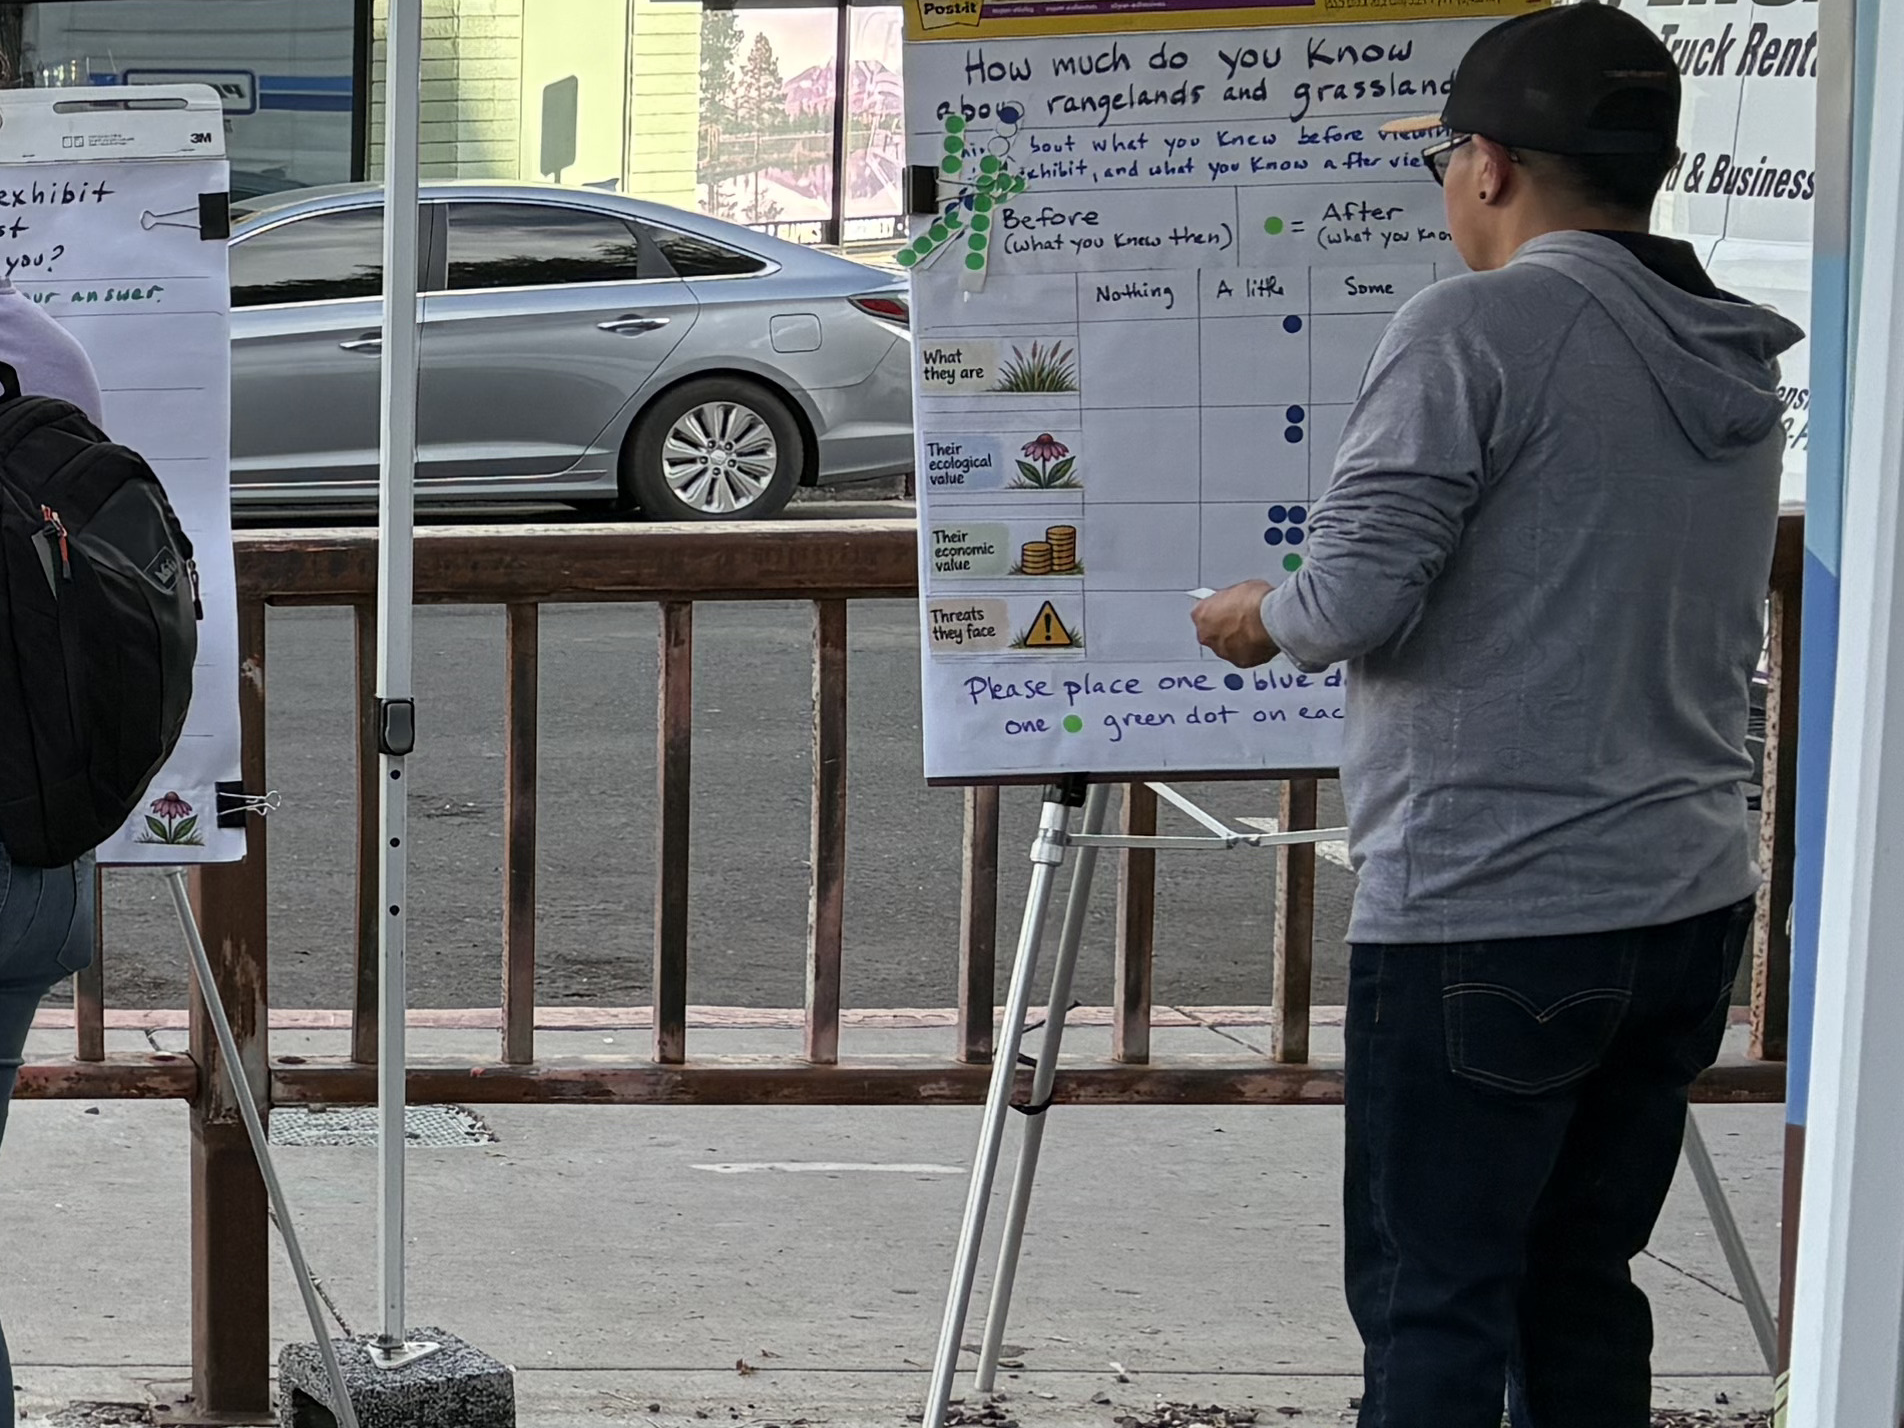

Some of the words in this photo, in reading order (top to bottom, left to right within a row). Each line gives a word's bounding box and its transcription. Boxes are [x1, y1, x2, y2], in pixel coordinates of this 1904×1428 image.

[923, 2, 977, 16] Post-it
[1661, 22, 1737, 77] Truck
[965, 48, 1032, 85] How
[1052, 42, 1131, 78] much
[1148, 41, 1189, 70] do
[1218, 47, 1282, 80] you
[936, 94, 1007, 122] abou
[1047, 80, 1205, 128] rangelands
[1223, 77, 1268, 102] and
[1290, 69, 1457, 123] grassland
[190, 132, 212, 144] 3M
[1030, 134, 1076, 154] bout
[1092, 132, 1148, 152] what
[1164, 136, 1200, 159] you
[1298, 125, 1364, 146] before
[1104, 159, 1139, 177] and
[1149, 159, 1195, 176] what
[1209, 161, 1240, 182] you
[1389, 152, 1425, 167] vie
[1683, 152, 1707, 194] &
[1705, 153, 1816, 201] Business
[1003, 207, 1099, 231] Before
[1322, 200, 1404, 222] After
[1004, 232, 1065, 255] (what
[1068, 234, 1104, 255] you
[1169, 223, 1233, 251] then)
[1317, 225, 1373, 250] (what
[1381, 229, 1410, 249] you
[6, 244, 65, 277] you?
[1096, 282, 1174, 309] Nothing
[1217, 280, 1233, 299] A
[1344, 276, 1395, 297] Some
[923, 348, 963, 365] What
[924, 366, 955, 385] they
[960, 366, 984, 380] are
[927, 441, 962, 457] Their
[929, 453, 992, 473] ecological
[930, 472, 964, 485] value
[932, 529, 968, 545] Their
[934, 542, 995, 558] economic
[935, 558, 971, 572] value
[930, 606, 985, 624] Threats
[932, 622, 963, 645] they
[966, 623, 996, 638] face
[963, 674, 1054, 706] Please
[1062, 671, 1143, 707] place
[1158, 673, 1218, 692] one
[1253, 670, 1315, 691] blue
[1004, 716, 1050, 736] one
[1103, 708, 1177, 742] green
[1186, 704, 1241, 726] dot
[1252, 706, 1287, 723] on
[1298, 703, 1345, 721] eac
